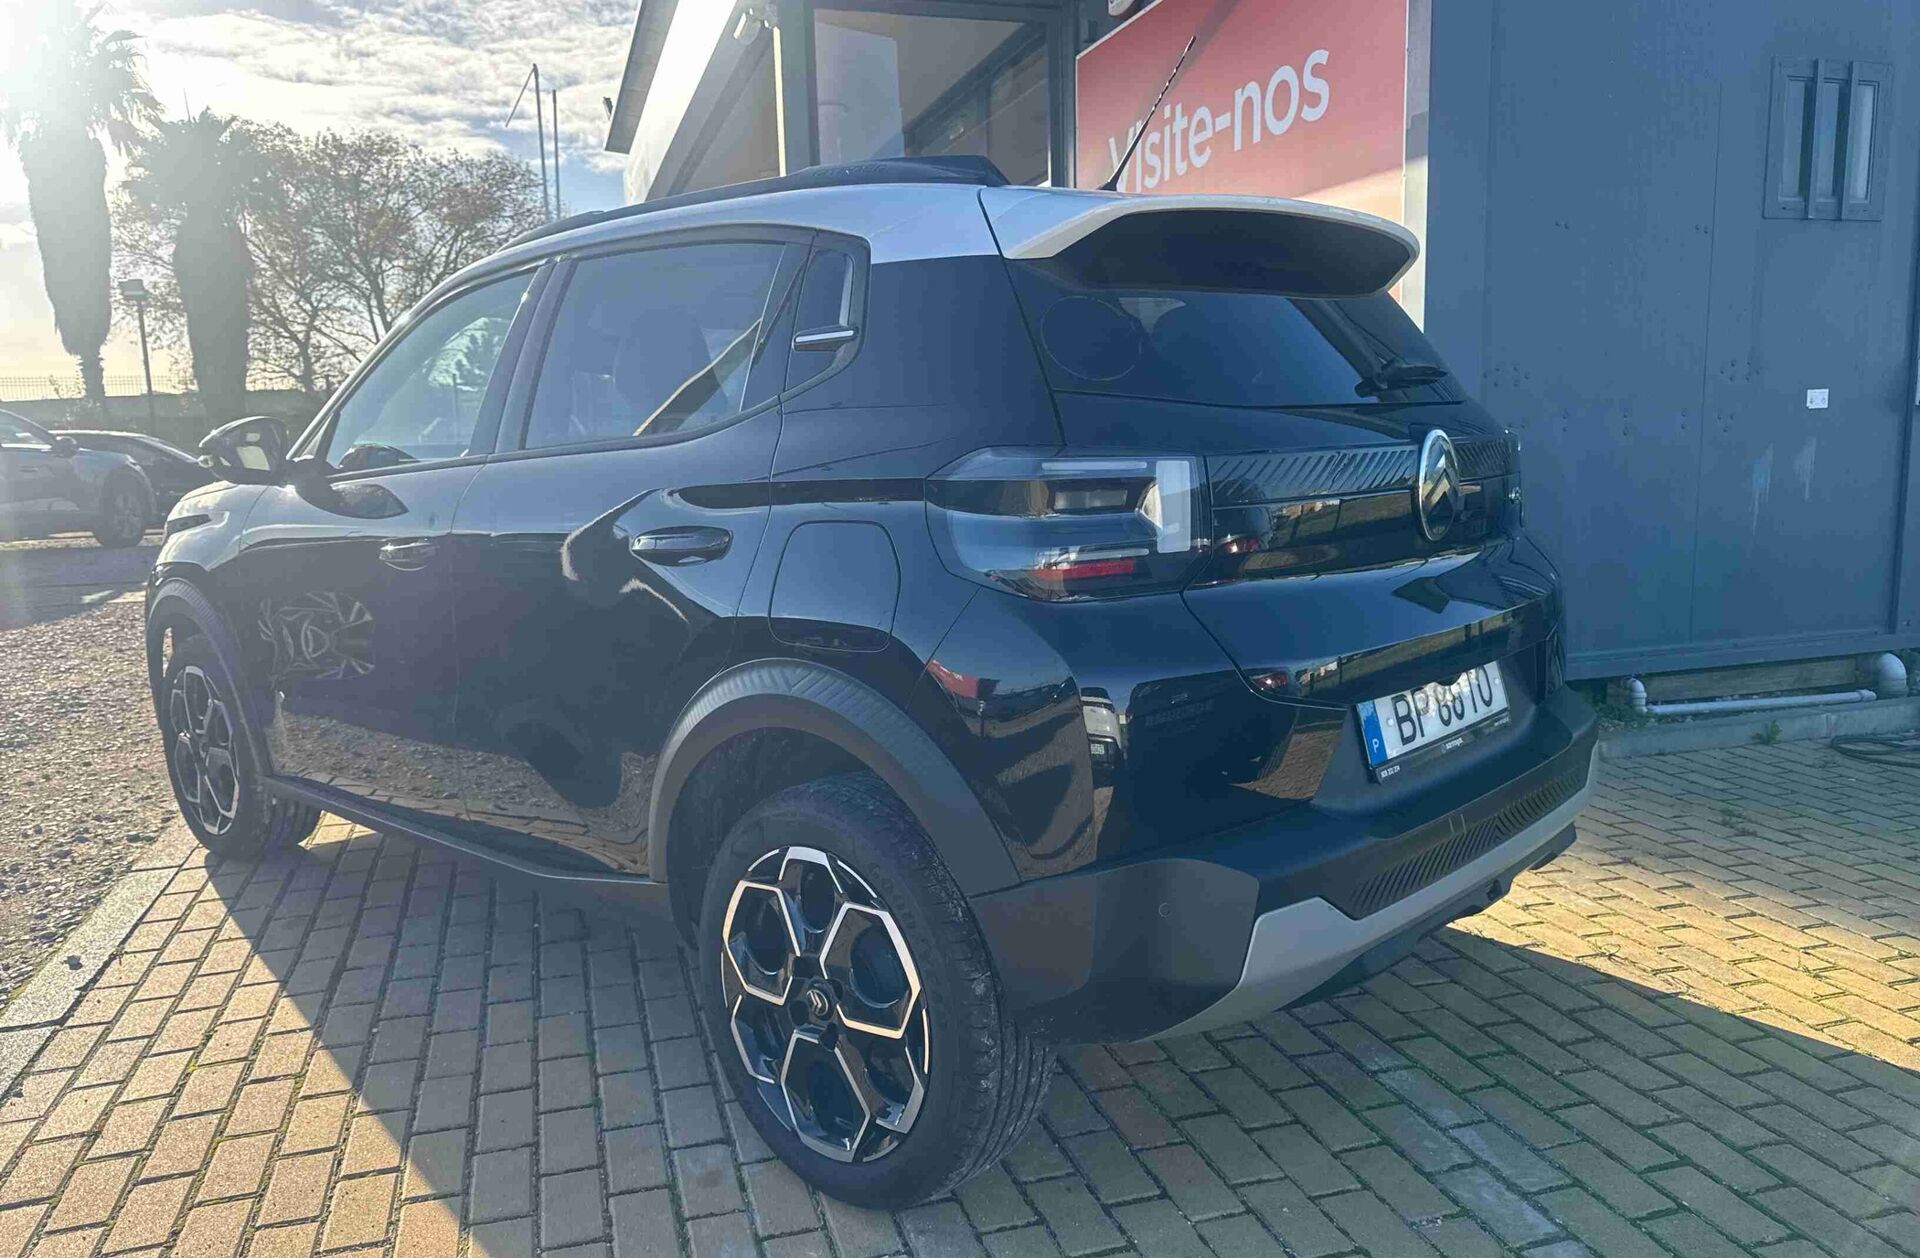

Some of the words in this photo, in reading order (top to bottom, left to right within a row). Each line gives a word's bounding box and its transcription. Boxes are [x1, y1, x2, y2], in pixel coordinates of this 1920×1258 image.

[1108, 49, 1330, 193] Visite-nos
[1372, 738, 1380, 752] P
[1391, 687, 1430, 746] BP
